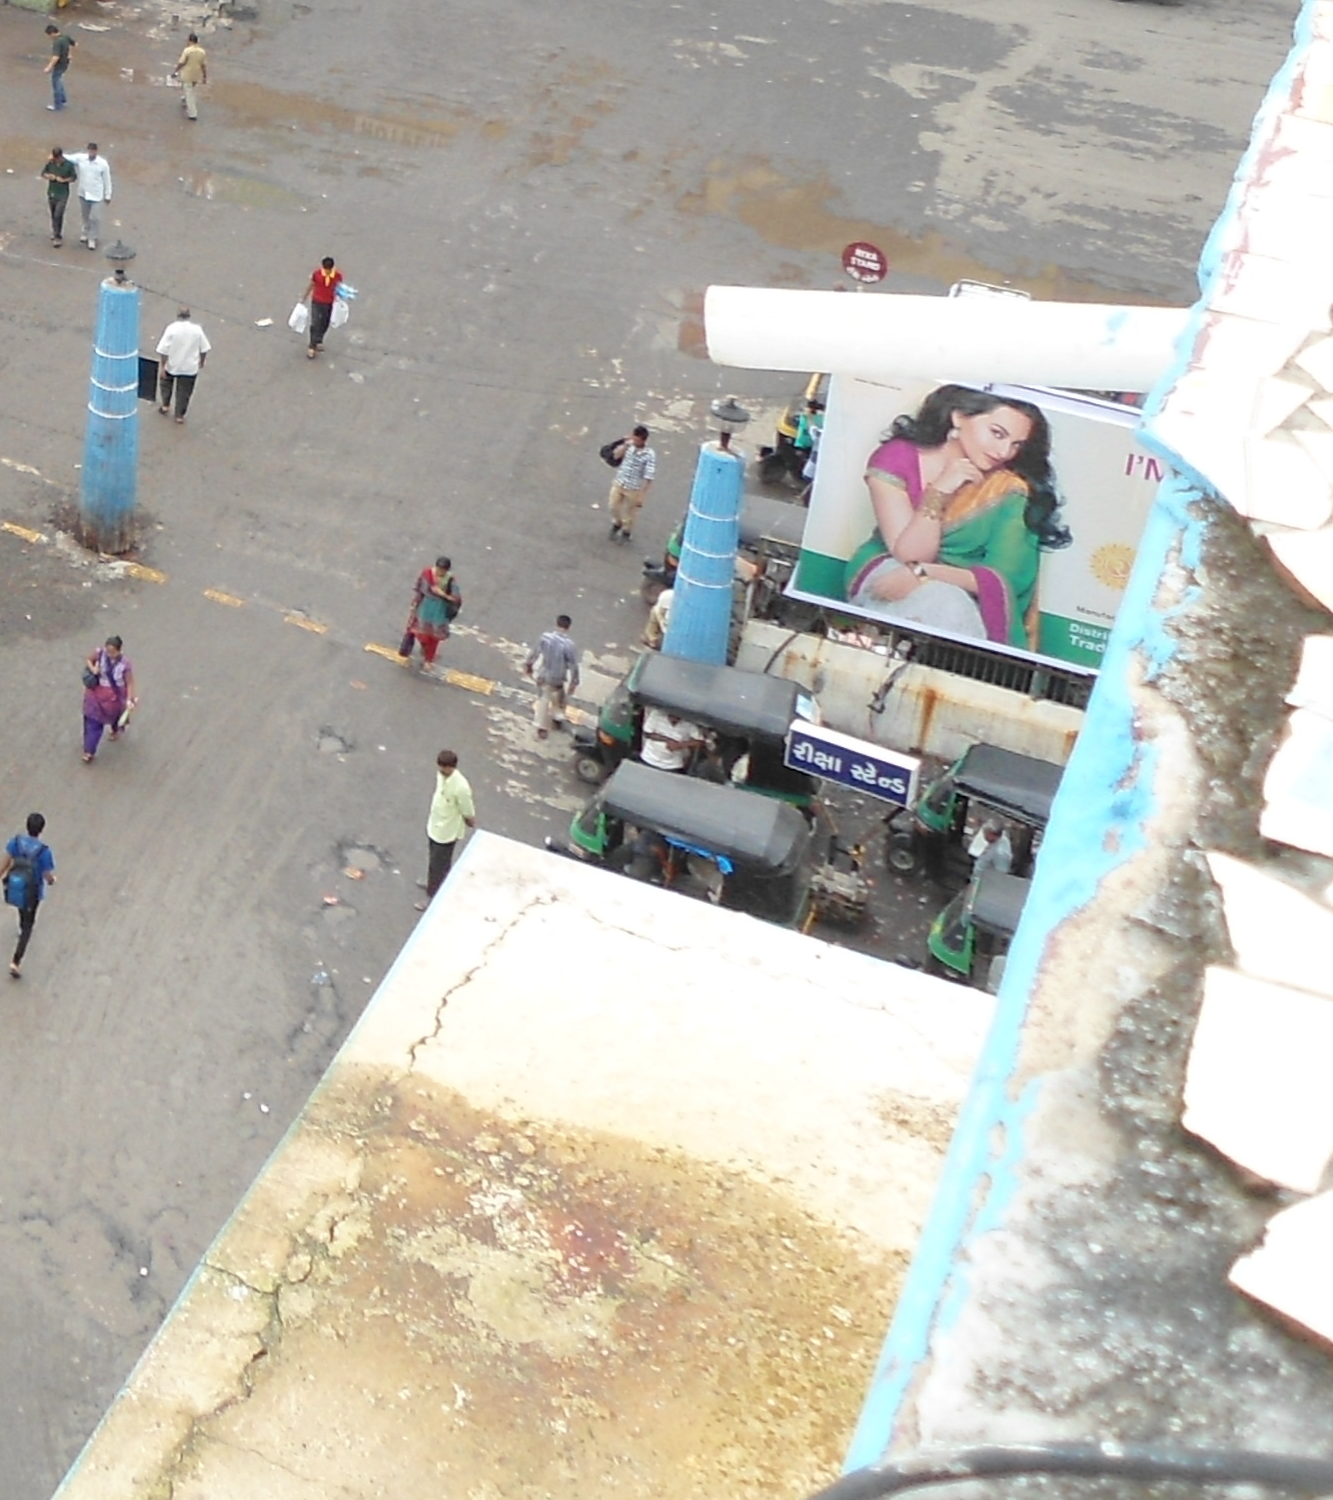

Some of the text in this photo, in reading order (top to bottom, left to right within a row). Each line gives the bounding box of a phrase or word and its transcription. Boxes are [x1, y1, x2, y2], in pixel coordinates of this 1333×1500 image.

[1068, 622, 1107, 641] Distri
[1068, 635, 1107, 653] Trad
[792, 742, 842, 775] રીક્ષા
